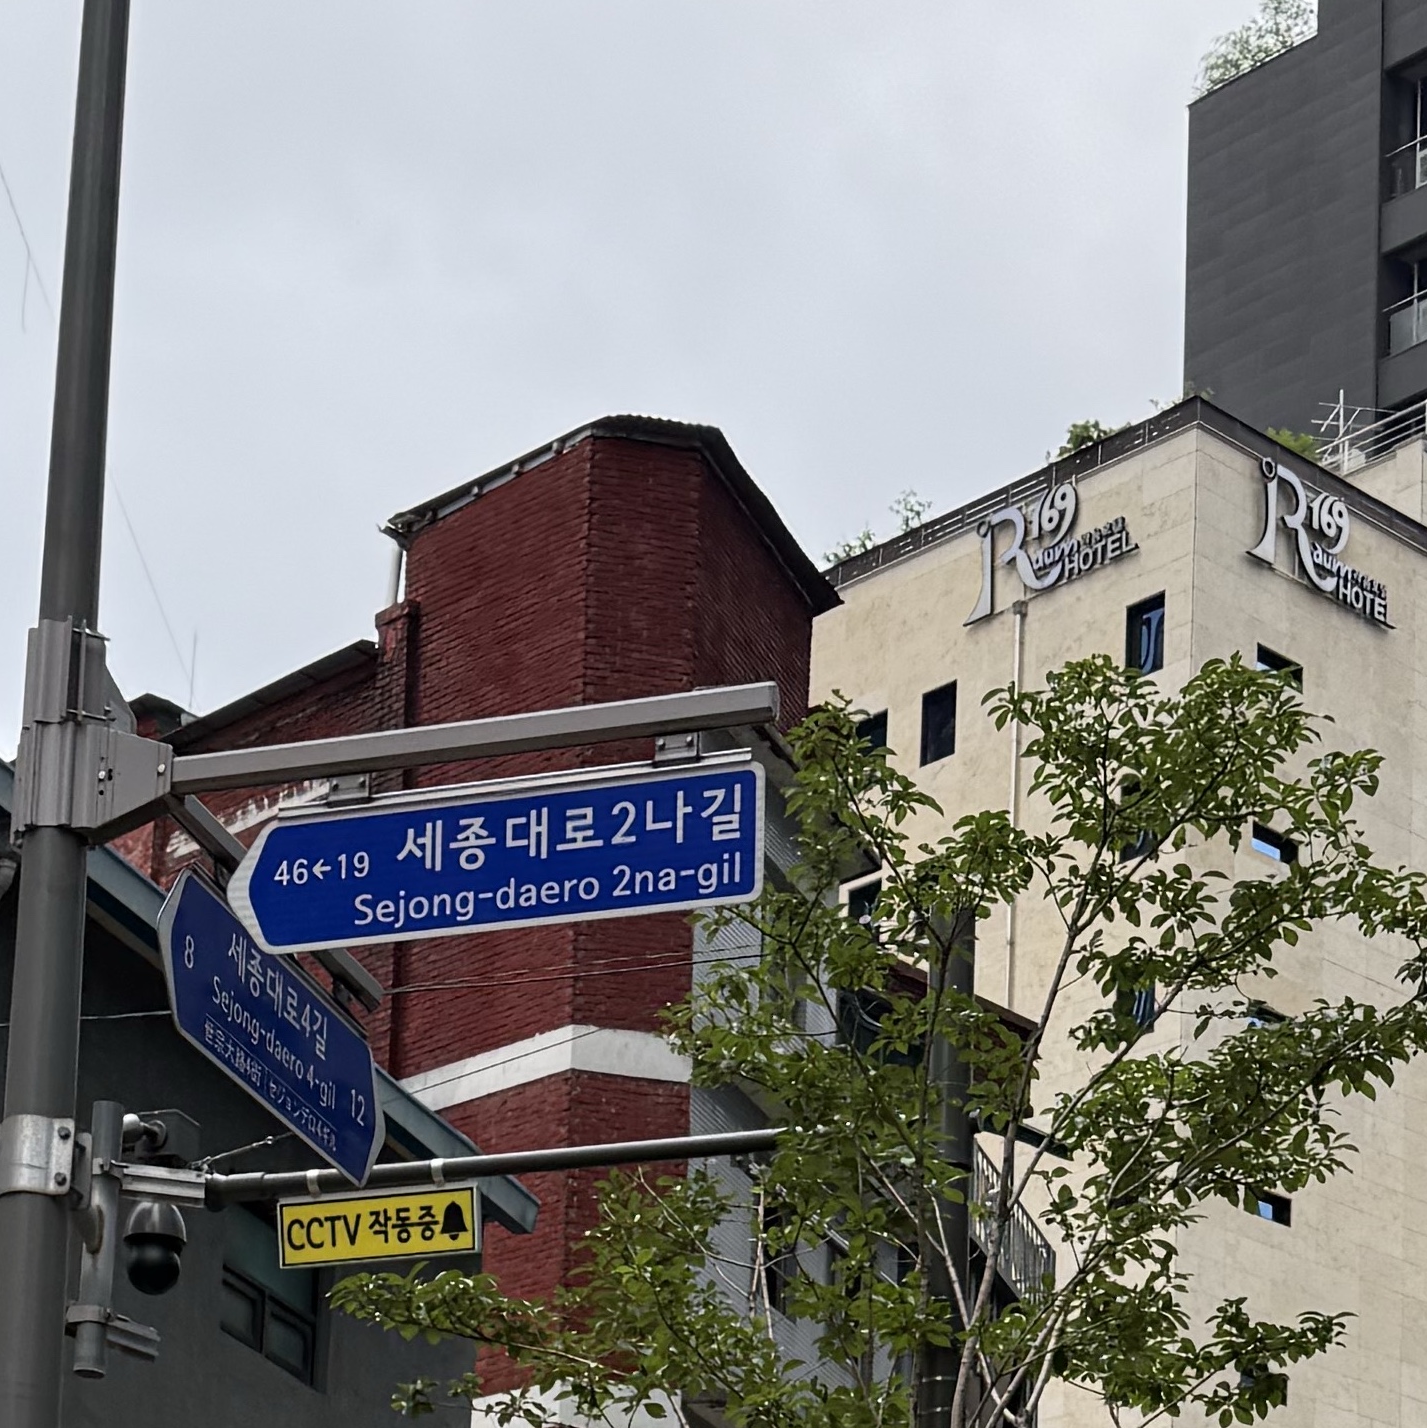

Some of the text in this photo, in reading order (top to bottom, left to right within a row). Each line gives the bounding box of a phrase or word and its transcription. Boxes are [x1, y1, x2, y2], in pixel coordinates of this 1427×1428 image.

[1064, 530, 1137, 579] HOTEL
[396, 782, 743, 873] 세종대로2나길
[353, 851, 742, 929] Sejong-daero 2na-gil
[184, 934, 195, 969] 8
[228, 932, 328, 1061] 세종대로4길
[212, 974, 337, 1110] Sejong-daero 4-gil
[350, 1088, 366, 1127] 12
[286, 1205, 440, 1251] CCTV 작동중
